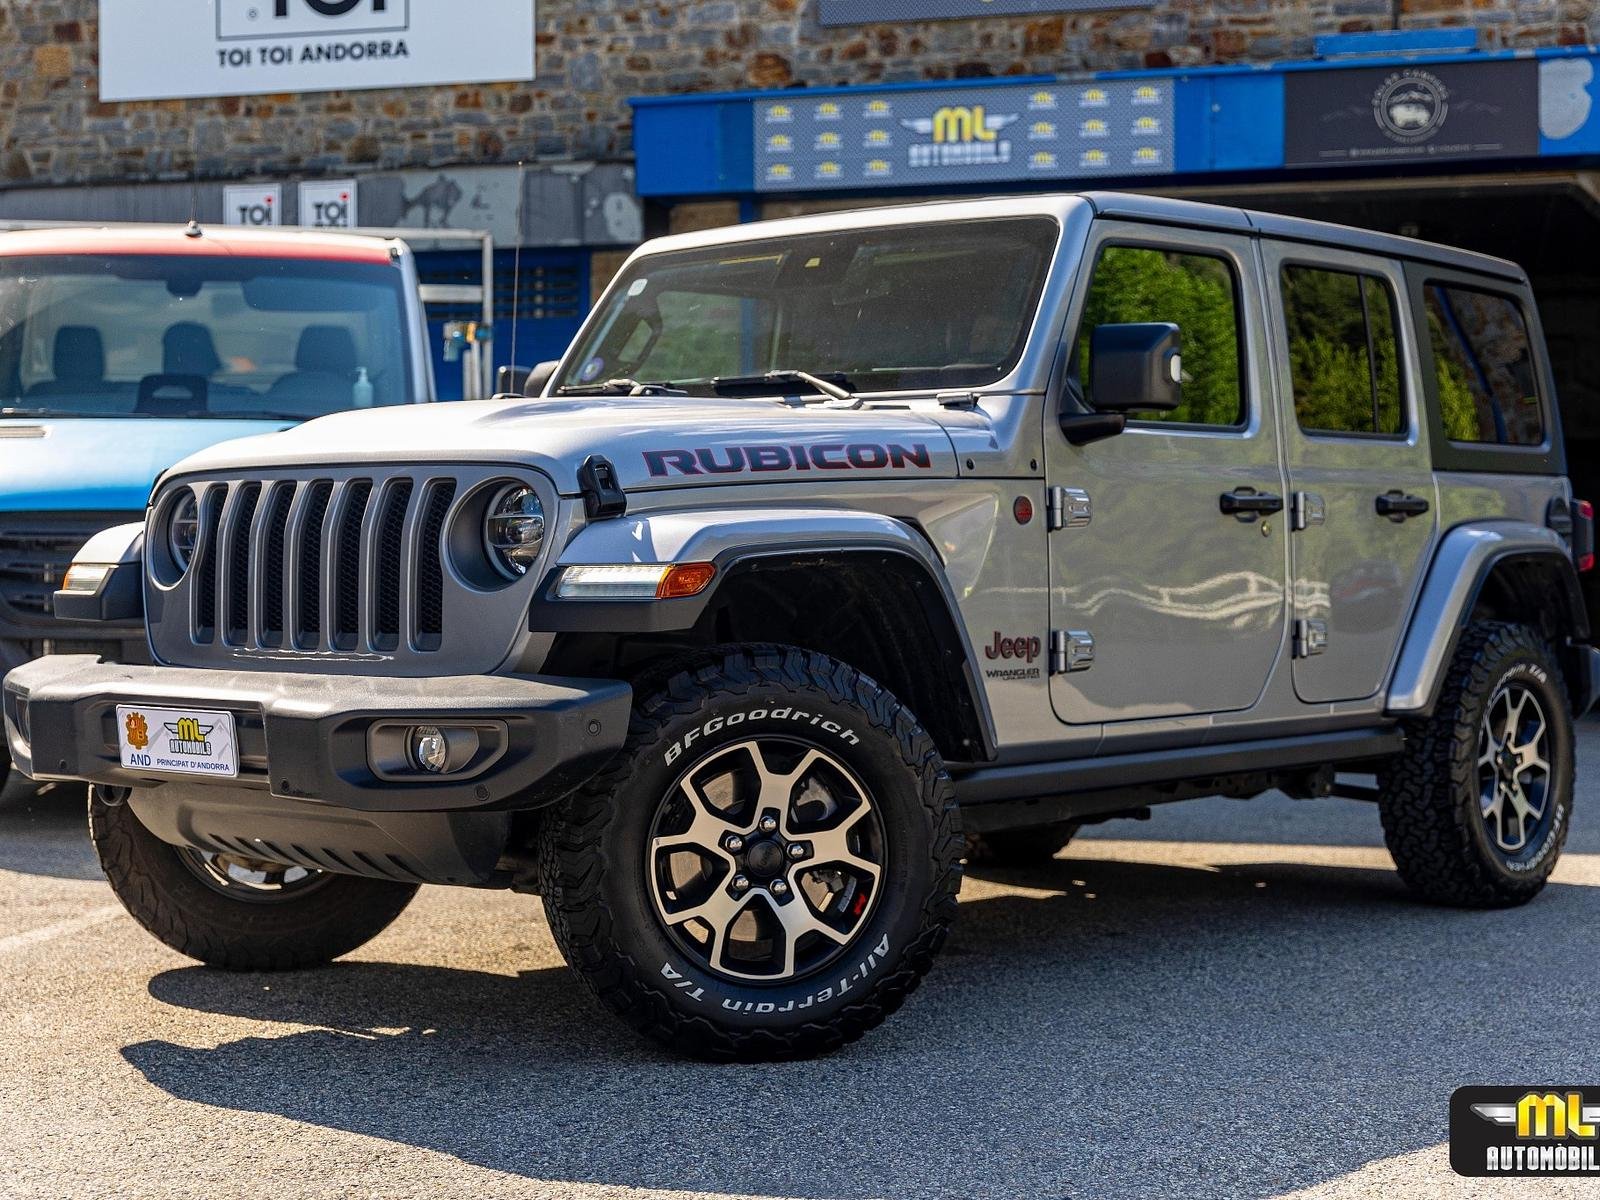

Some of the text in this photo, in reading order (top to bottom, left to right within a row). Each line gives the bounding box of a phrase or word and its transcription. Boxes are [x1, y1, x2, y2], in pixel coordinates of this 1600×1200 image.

[218, 41, 409, 66] TOI TOI ANDORRA
[932, 104, 997, 144] ML
[641, 443, 931, 477] RUBICON
[985, 631, 1041, 663] Jeep
[985, 668, 1040, 678] WRANGLER
[177, 717, 206, 742] ML
[663, 706, 860, 767] BFGoodrich
[130, 753, 152, 766] AND
[156, 758, 189, 768] PRINCIPAT
[660, 933, 890, 1015] All-Terrain T/A
